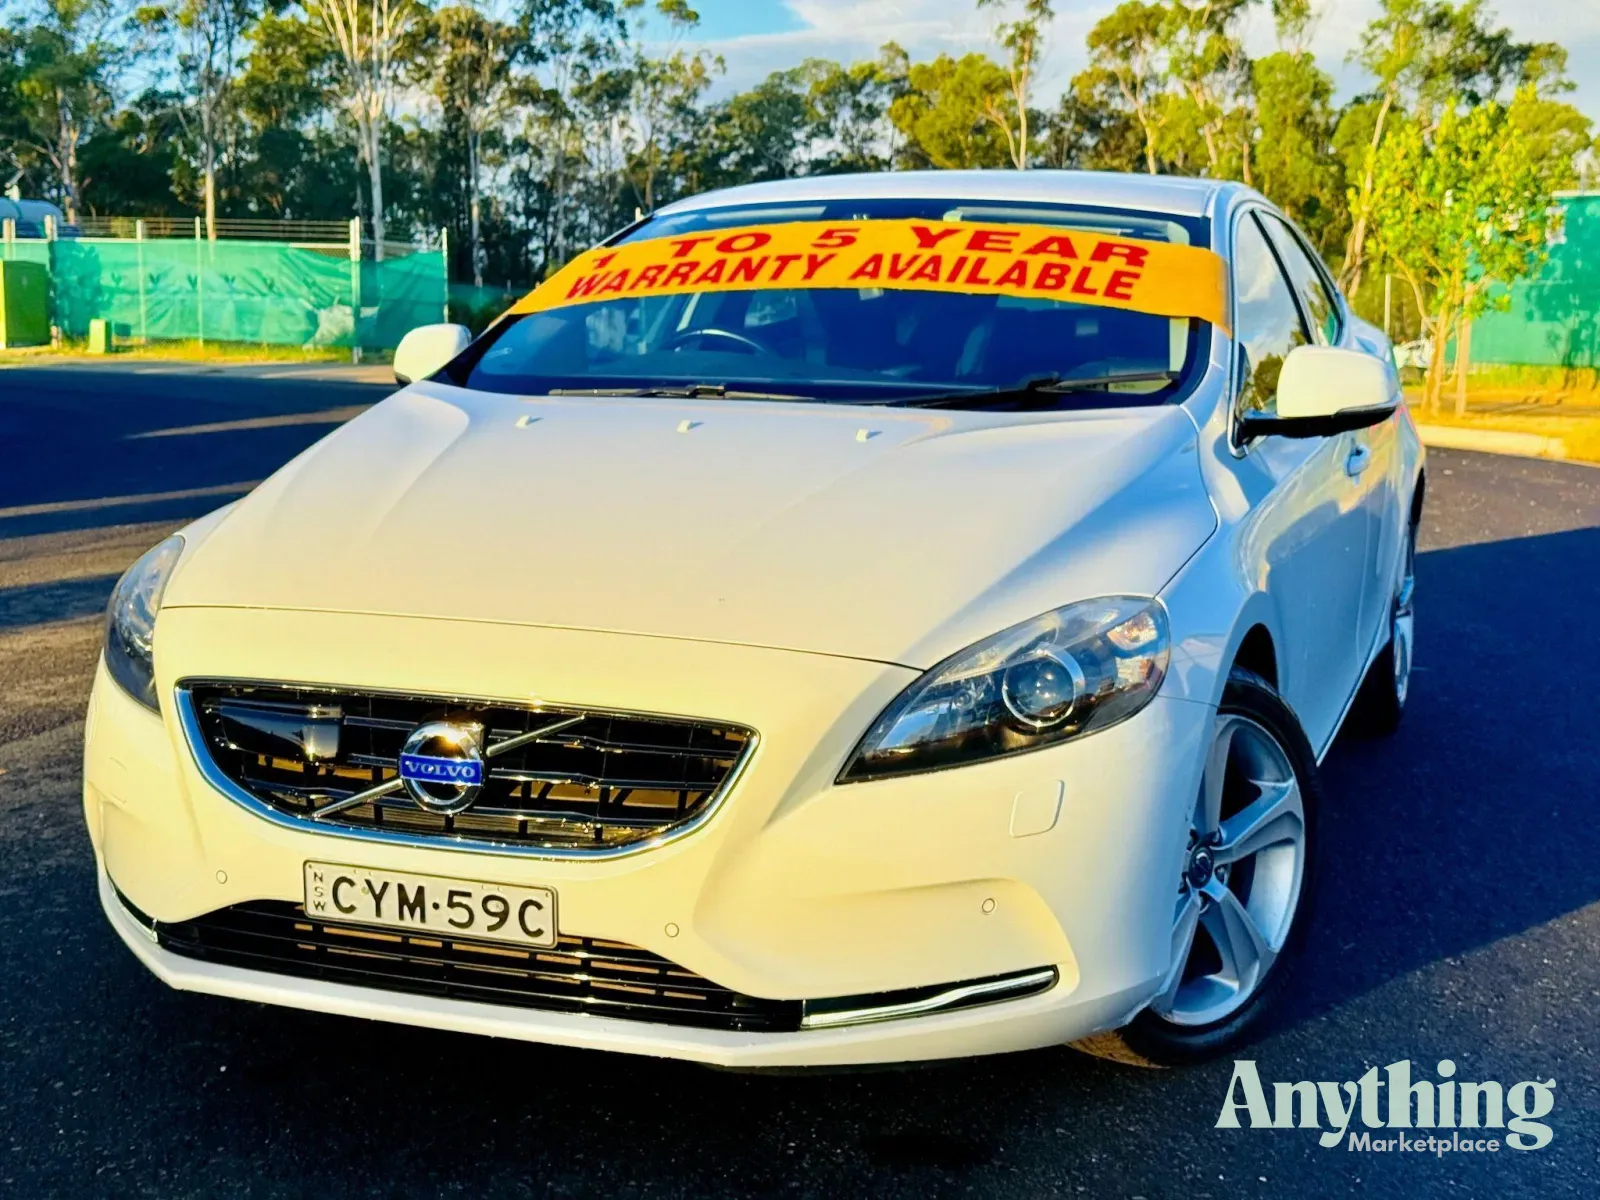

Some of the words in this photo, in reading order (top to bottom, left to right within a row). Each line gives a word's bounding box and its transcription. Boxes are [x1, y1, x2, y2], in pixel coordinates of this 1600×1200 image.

[592, 252, 619, 269] 1
[671, 232, 771, 258] TO
[811, 229, 861, 248] 5
[910, 226, 1150, 267] YEAR
[565, 253, 838, 300] WARRANTY
[848, 253, 1142, 300] AVAILABLE
[407, 761, 476, 778] VOLVO
